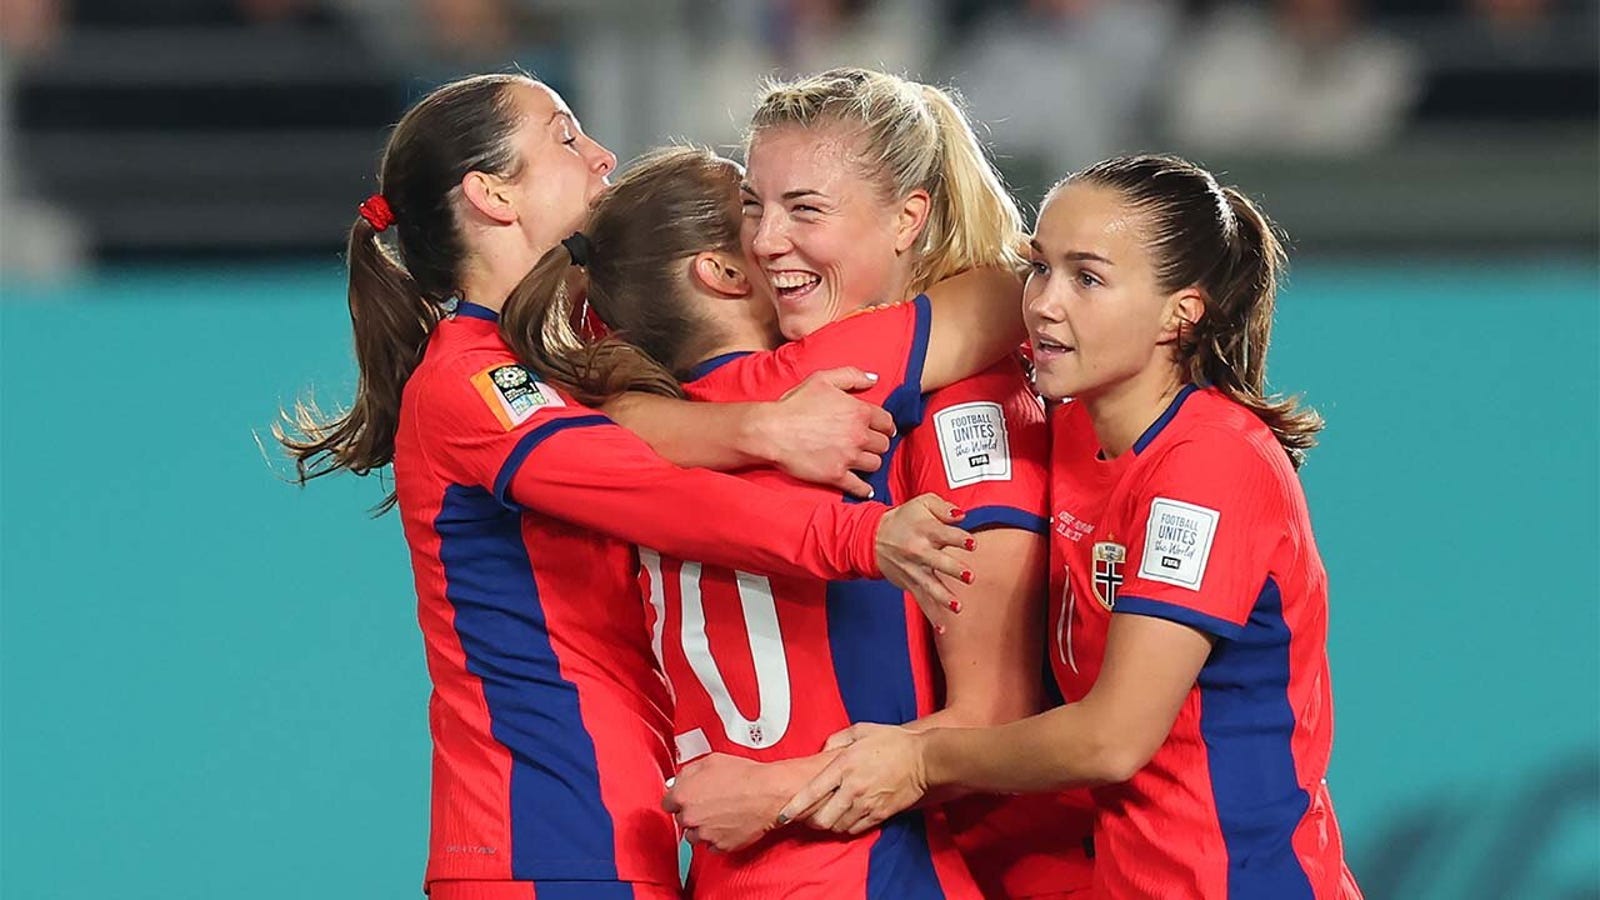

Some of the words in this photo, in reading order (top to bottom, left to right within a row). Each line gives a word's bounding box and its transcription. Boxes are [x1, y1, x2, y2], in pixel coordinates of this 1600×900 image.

[951, 414, 992, 428] FOOTBALL
[953, 424, 995, 442] UNITES
[955, 444, 970, 457] the
[971, 438, 998, 453] World
[1161, 513, 1199, 531] FOOTBALL
[1158, 525, 1197, 545] UNITES
[1154, 540, 1168, 552] the
[1168, 543, 1197, 559] World
